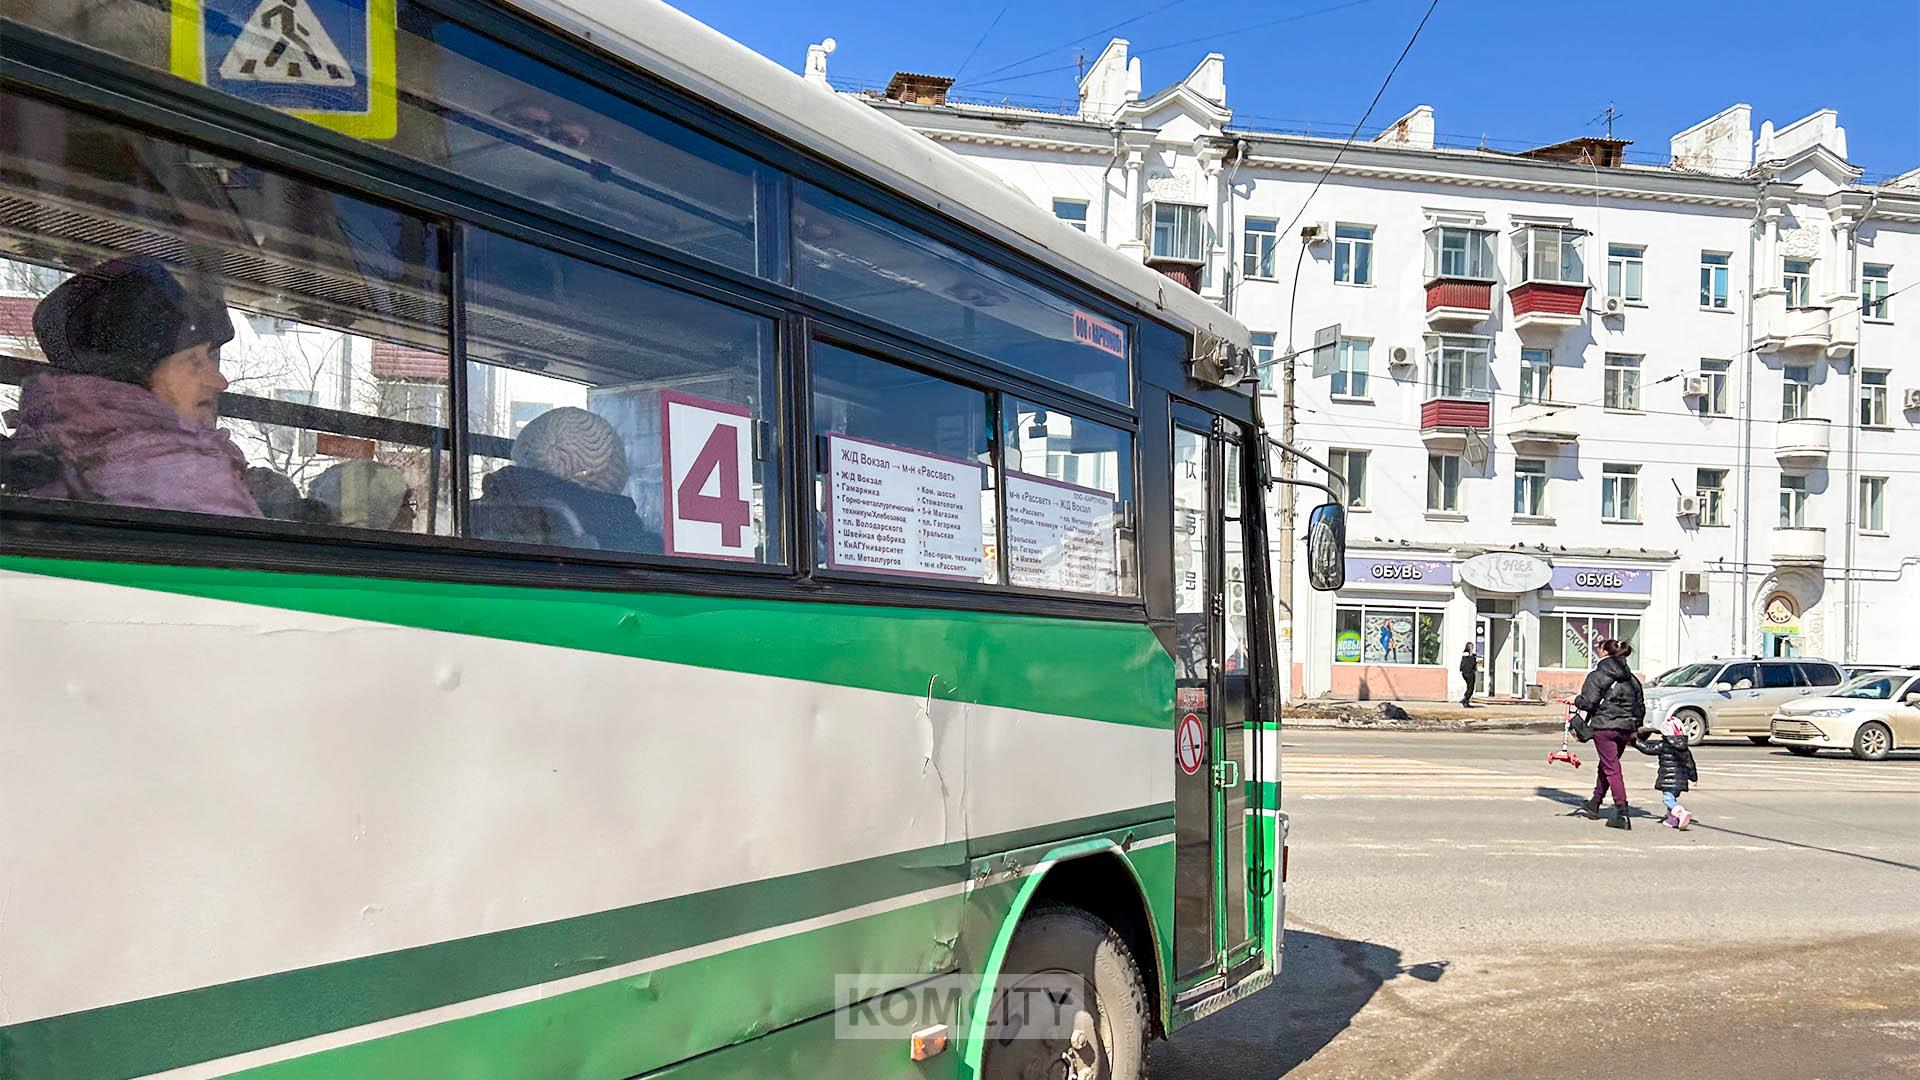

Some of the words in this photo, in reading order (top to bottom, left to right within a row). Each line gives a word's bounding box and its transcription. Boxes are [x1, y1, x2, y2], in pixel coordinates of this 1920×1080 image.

[841, 449, 859, 465] Ж/Д
[861, 454, 890, 470] Вокзал
[902, 466, 916, 475] м-н
[918, 466, 955, 482] «Рассвет»
[678, 423, 750, 548] 4
[841, 471, 856, 482] Ж/Д
[857, 474, 883, 486] Вокзал
[842, 483, 880, 497] Гамарника
[937, 490, 957, 500] шоссе
[921, 497, 964, 511] Стоматология
[1021, 492, 1052, 506] «Рассвет»
[933, 509, 959, 520] Магазин
[842, 519, 854, 528] пл.
[855, 520, 903, 533] Володарского
[922, 519, 932, 528] пл.
[933, 519, 961, 531] Гагарина
[843, 528, 875, 540] Швейная
[876, 533, 906, 545] фабрика
[922, 529, 955, 540] Уральская
[843, 540, 904, 554] КнАГУниверситет
[844, 552, 856, 561] пл.
[857, 553, 902, 566] Металлургов
[954, 555, 982, 564] техникум
[936, 562, 967, 573] «Рассвет»
[1371, 563, 1423, 580] ОБУВЬ
[1575, 572, 1623, 588] ОБУВЬ
